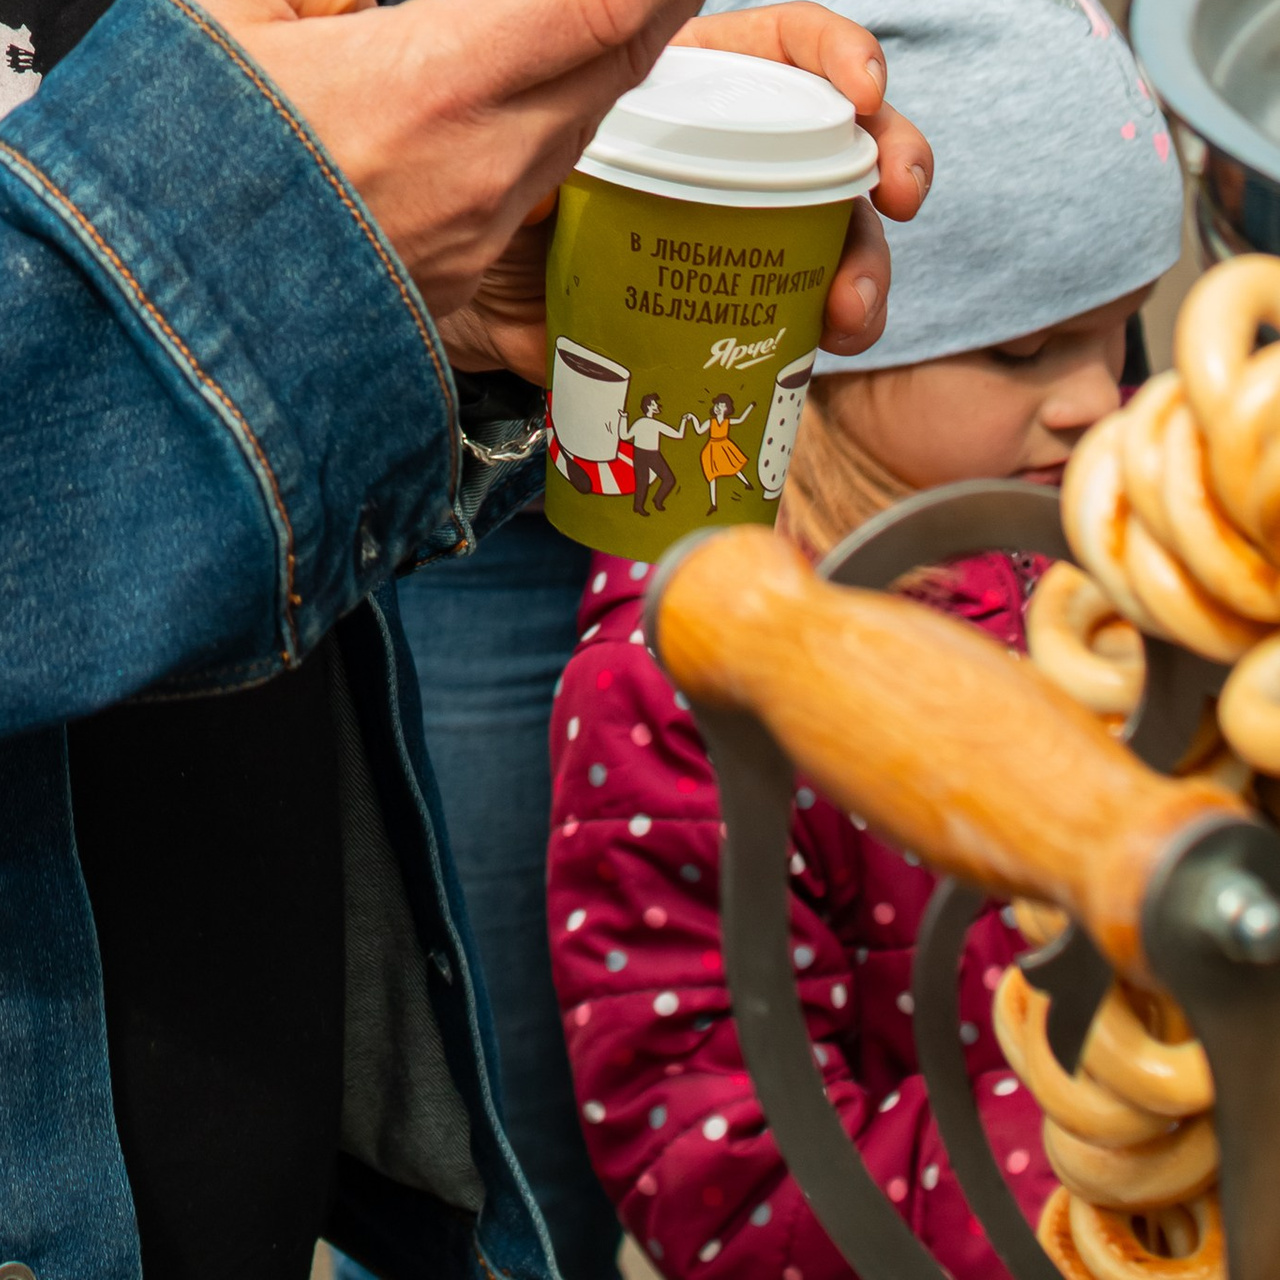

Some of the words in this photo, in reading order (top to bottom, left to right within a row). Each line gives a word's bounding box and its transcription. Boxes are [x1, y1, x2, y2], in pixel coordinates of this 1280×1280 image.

[630, 231, 642, 252] В
[650, 237, 785, 268] ЛЮБИМОМ
[658, 265, 742, 297] ГОРОДЕ
[750, 266, 825, 297] ПРИЯТНО
[624, 286, 778, 327] ЗАБЛУДИТЬСЯ
[702, 327, 787, 371] Ярче!
